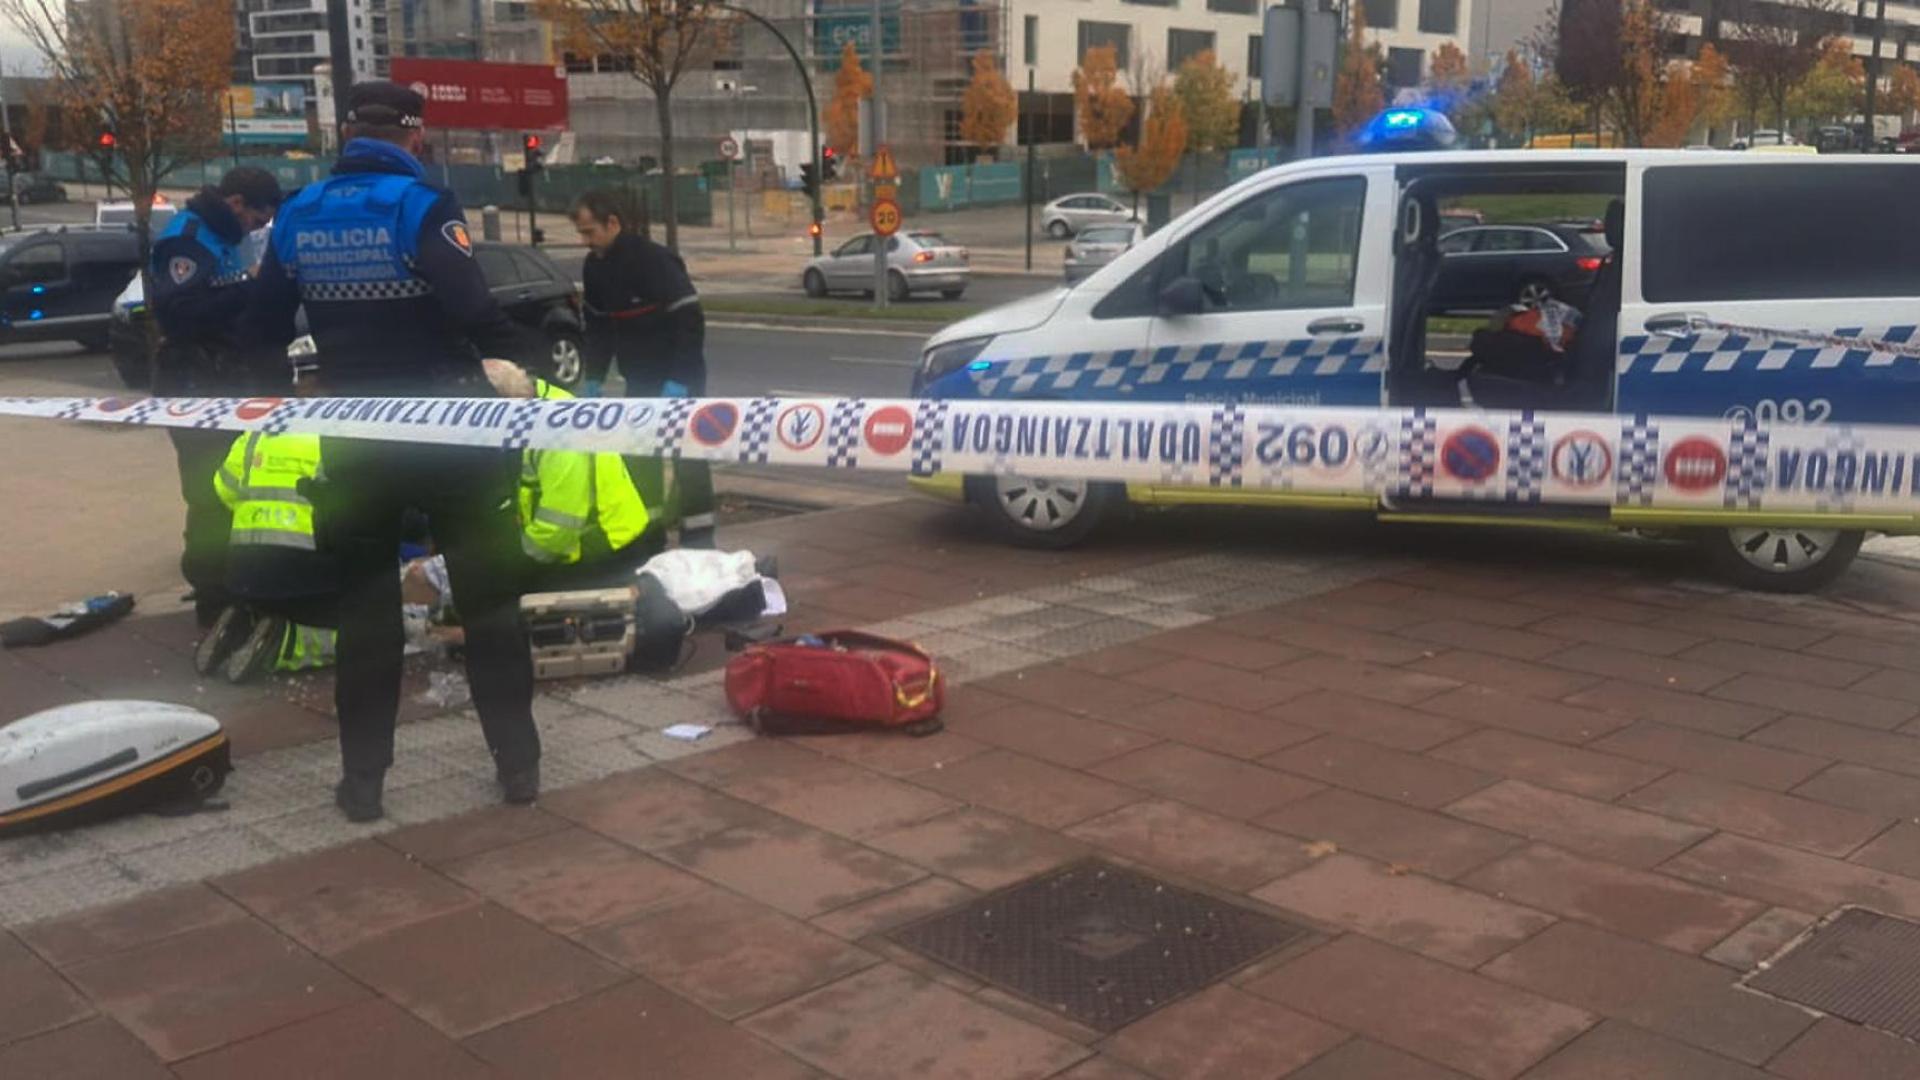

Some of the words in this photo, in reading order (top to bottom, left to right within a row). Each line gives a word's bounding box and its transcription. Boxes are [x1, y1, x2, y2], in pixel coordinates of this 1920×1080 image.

[296, 227, 392, 249] POLICIA
[297, 249, 393, 264] MUNICIPAL
[304, 399, 511, 428] UDALTZAINGOA
[547, 402, 624, 430] 092
[1755, 398, 1833, 425] 092
[952, 413, 1201, 463] UDALTZAINGOA
[1256, 423, 1348, 466] 092
